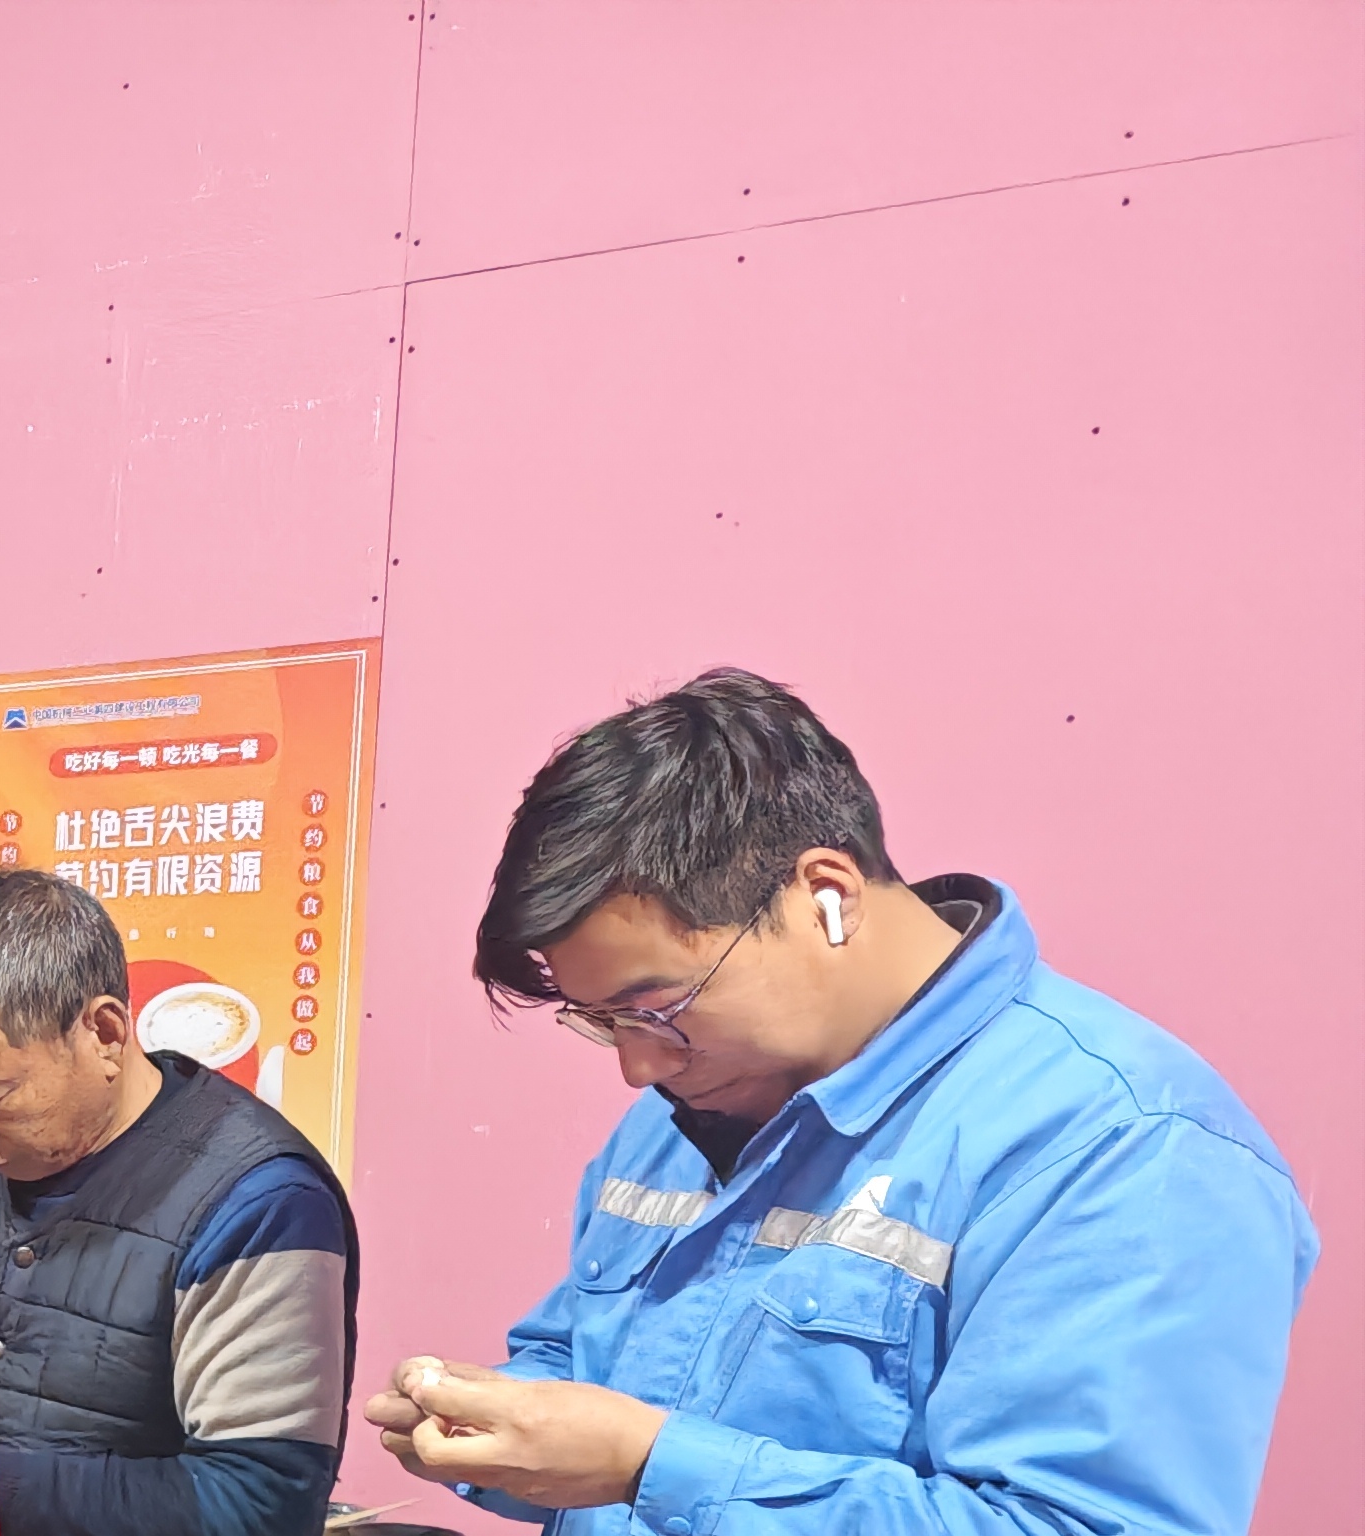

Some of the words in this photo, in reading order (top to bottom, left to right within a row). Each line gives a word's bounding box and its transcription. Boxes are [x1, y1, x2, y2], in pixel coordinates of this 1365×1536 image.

[65, 747, 158, 772] 吃好每一顿
[162, 739, 259, 766] 吃光每一餐
[54, 800, 265, 852] 杜绝舌尖浪费
[54, 851, 263, 899] 节约有限资源
[293, 793, 325, 1052] 节约粮食从我做起
